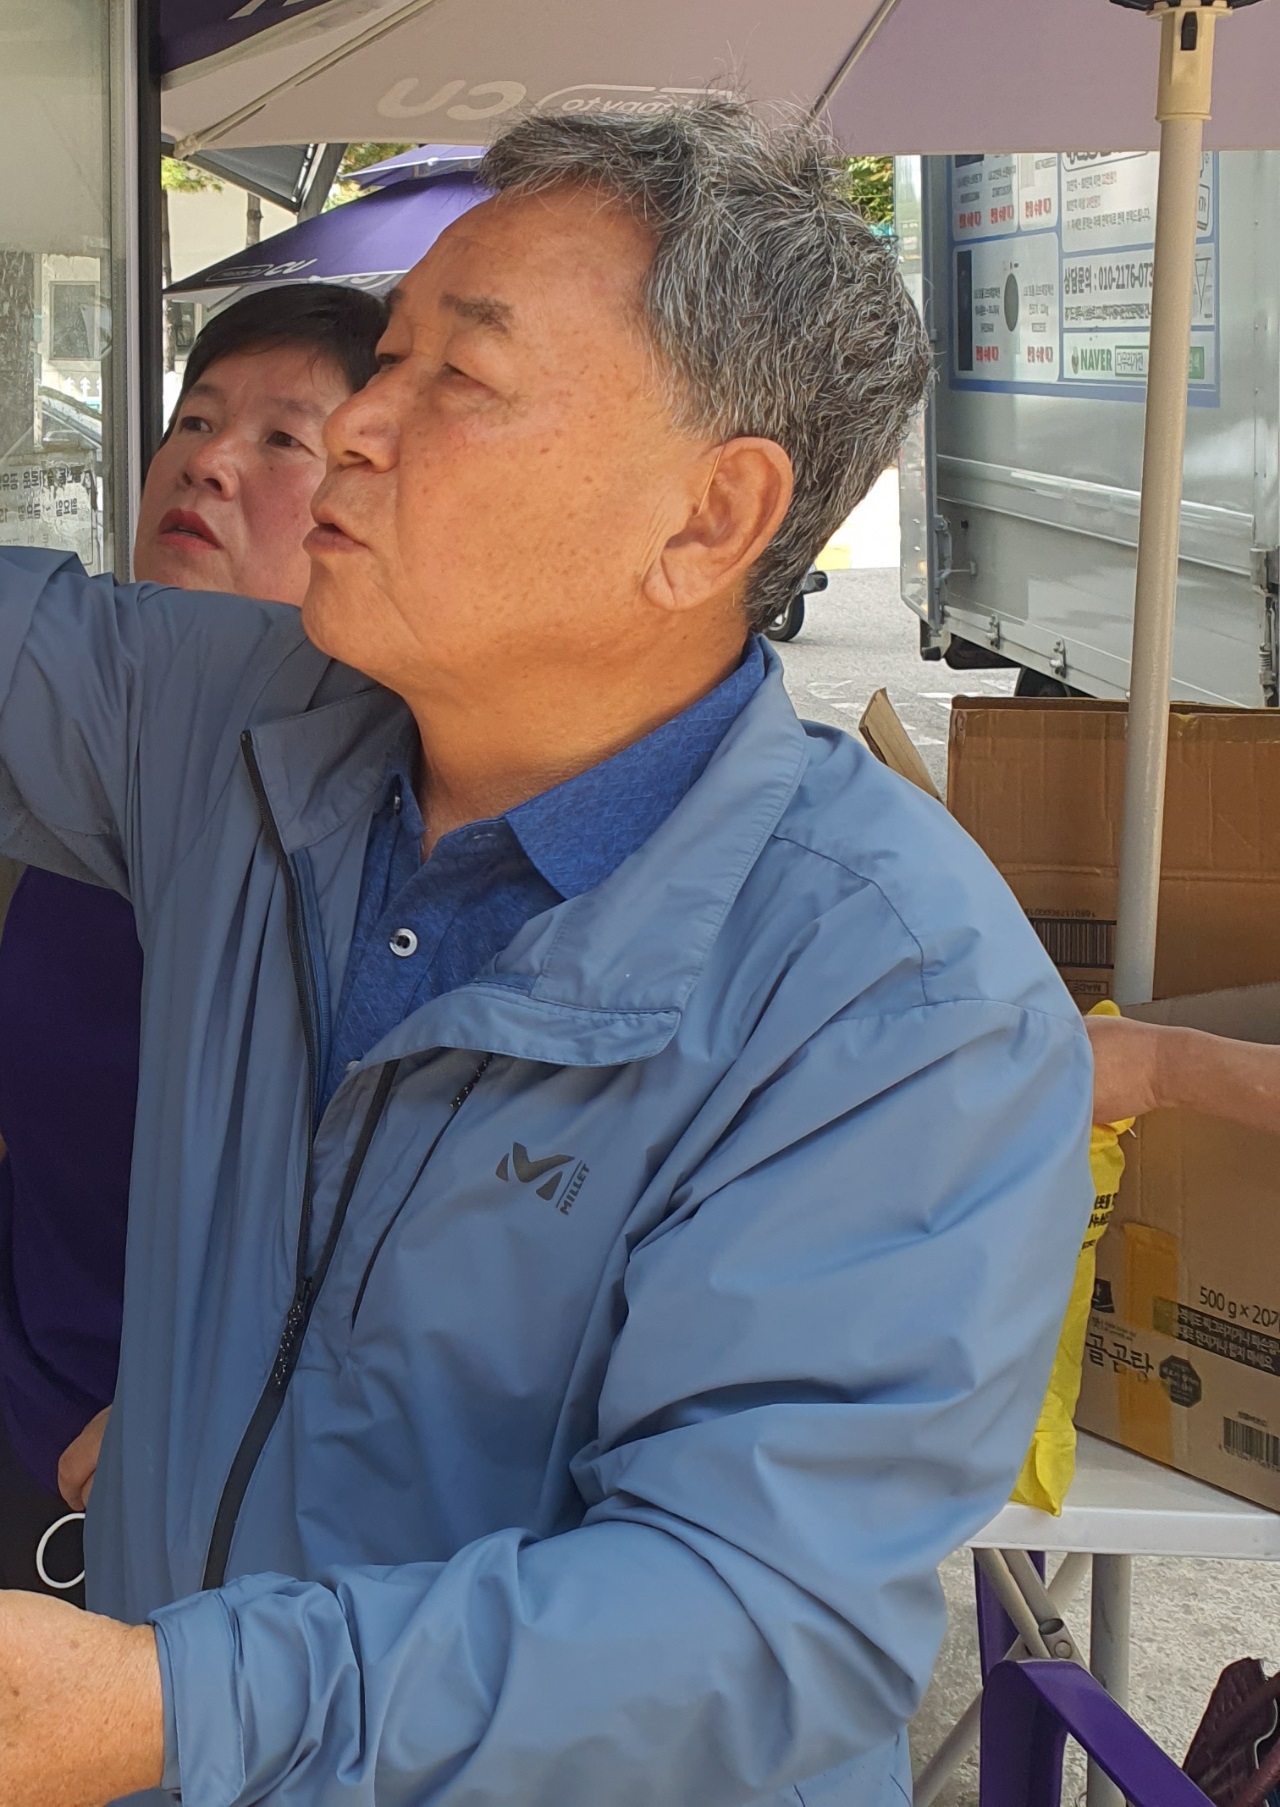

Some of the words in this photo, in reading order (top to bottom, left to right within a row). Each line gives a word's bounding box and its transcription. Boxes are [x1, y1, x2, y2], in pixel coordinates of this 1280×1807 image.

[264, 257, 318, 277] CU
[1064, 265, 1092, 295] 상담문의
[1080, 348, 1113, 371] NAVER
[560, 1162, 590, 1216] MILLET
[1200, 1285, 1225, 1312] 500
[1086, 1332, 1154, 1383] 골곰탕
